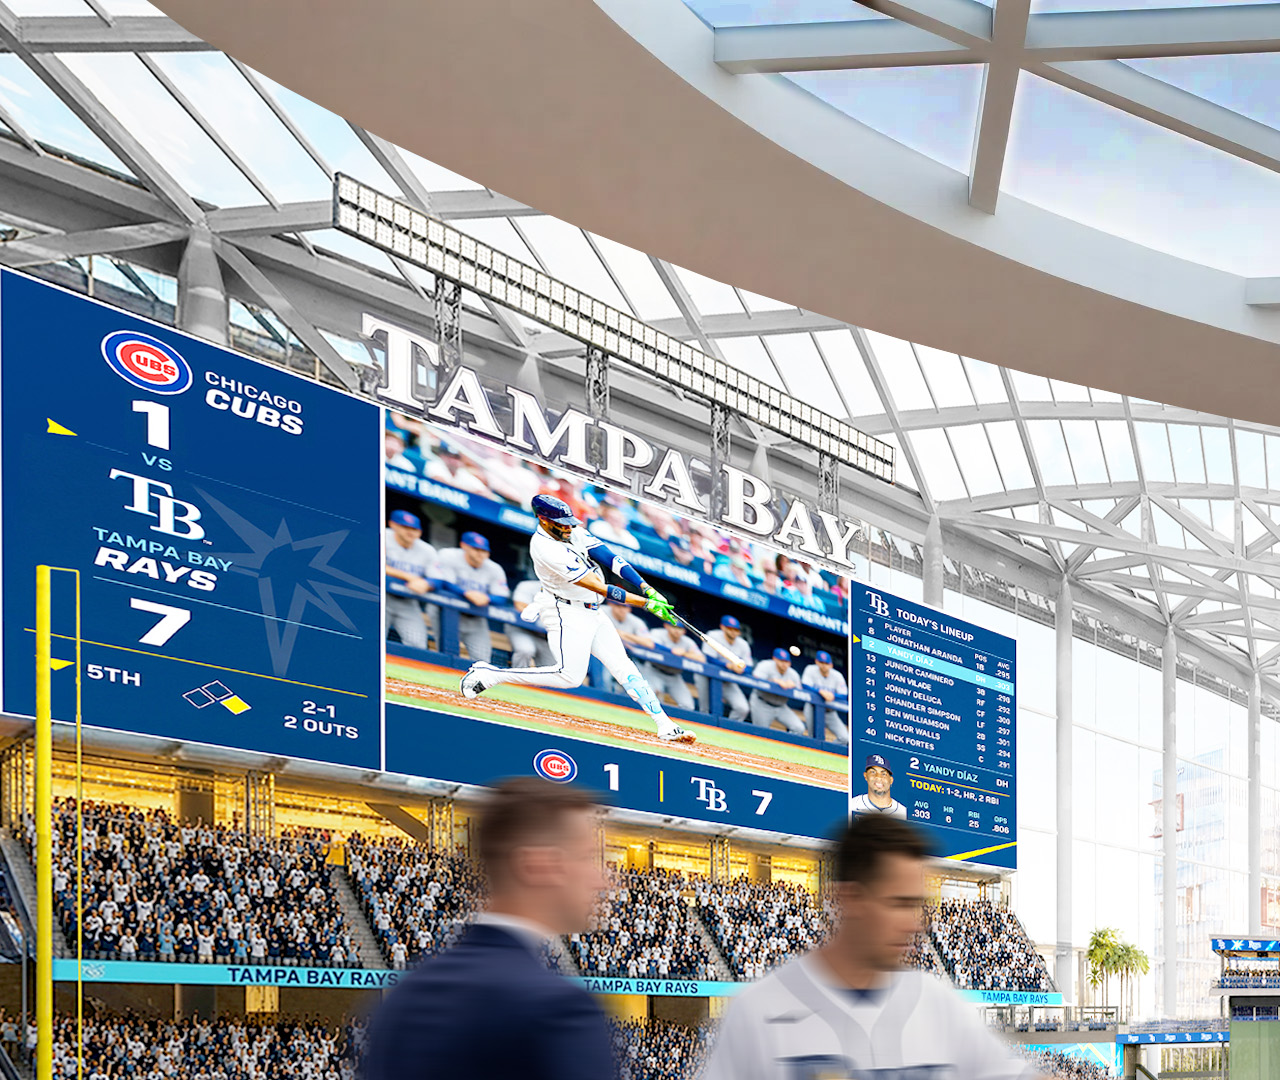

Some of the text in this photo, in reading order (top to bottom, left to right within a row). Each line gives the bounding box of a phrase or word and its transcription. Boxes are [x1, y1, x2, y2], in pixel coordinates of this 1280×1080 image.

[205, 371, 302, 413] CHICAGO
[132, 401, 170, 450] 1
[205, 391, 303, 435] CUBS
[361, 312, 862, 570] TAMPA BAY
[141, 453, 173, 472] VS
[108, 468, 205, 541] TB
[92, 527, 233, 572] TAMPA BAY
[94, 547, 218, 591] RAYS
[130, 598, 191, 646] 7
[866, 590, 974, 642] TB TODAY'S LINEUP
[885, 622, 911, 637] PLAYER
[869, 640, 875, 648] 2
[887, 646, 914, 660] YANDY
[887, 634, 930, 654] JONATHAN
[931, 648, 963, 664] ARANDA
[87, 665, 141, 686] 5TH
[866, 654, 876, 662] 13
[885, 660, 914, 674] JUNIOR
[915, 669, 954, 686] CAMINERO
[866, 666, 877, 675] 26
[885, 671, 906, 683] RYAN
[866, 677, 876, 686] 21
[885, 683, 911, 696] JONNY
[913, 692, 942, 705] DELUCA
[302, 701, 336, 718] 2-1
[866, 690, 876, 699] 14
[885, 695, 926, 712] CHANDLER
[927, 707, 961, 722] SIMPSON
[866, 702, 876, 711] 15
[885, 707, 901, 718] BEN
[902, 712, 950, 731] WILLIAMSON
[284, 716, 359, 739] 2 OUTS
[865, 728, 877, 736] 40
[885, 732, 905, 743] NICK
[906, 737, 935, 751] FORTES
[885, 720, 914, 733] TAYLOR
[915, 728, 940, 740] WALLS
[604, 763, 619, 791] 1
[909, 757, 1009, 788] 2 YANDY DÍAZ DH
[690, 775, 727, 812] TB
[752, 790, 773, 815] 7
[910, 779, 944, 794] TODAY:
[946, 787, 962, 798] 1-2,
[985, 796, 999, 805] RBI
[915, 801, 1007, 824] AVG HR RBI OPS
[969, 820, 980, 828] 25
[227, 967, 398, 987] TAMPA BAY RAYS
[584, 979, 698, 994] TAMPA BAY RAYS
[982, 992, 1048, 1004] TAMPA BAY RAYS
